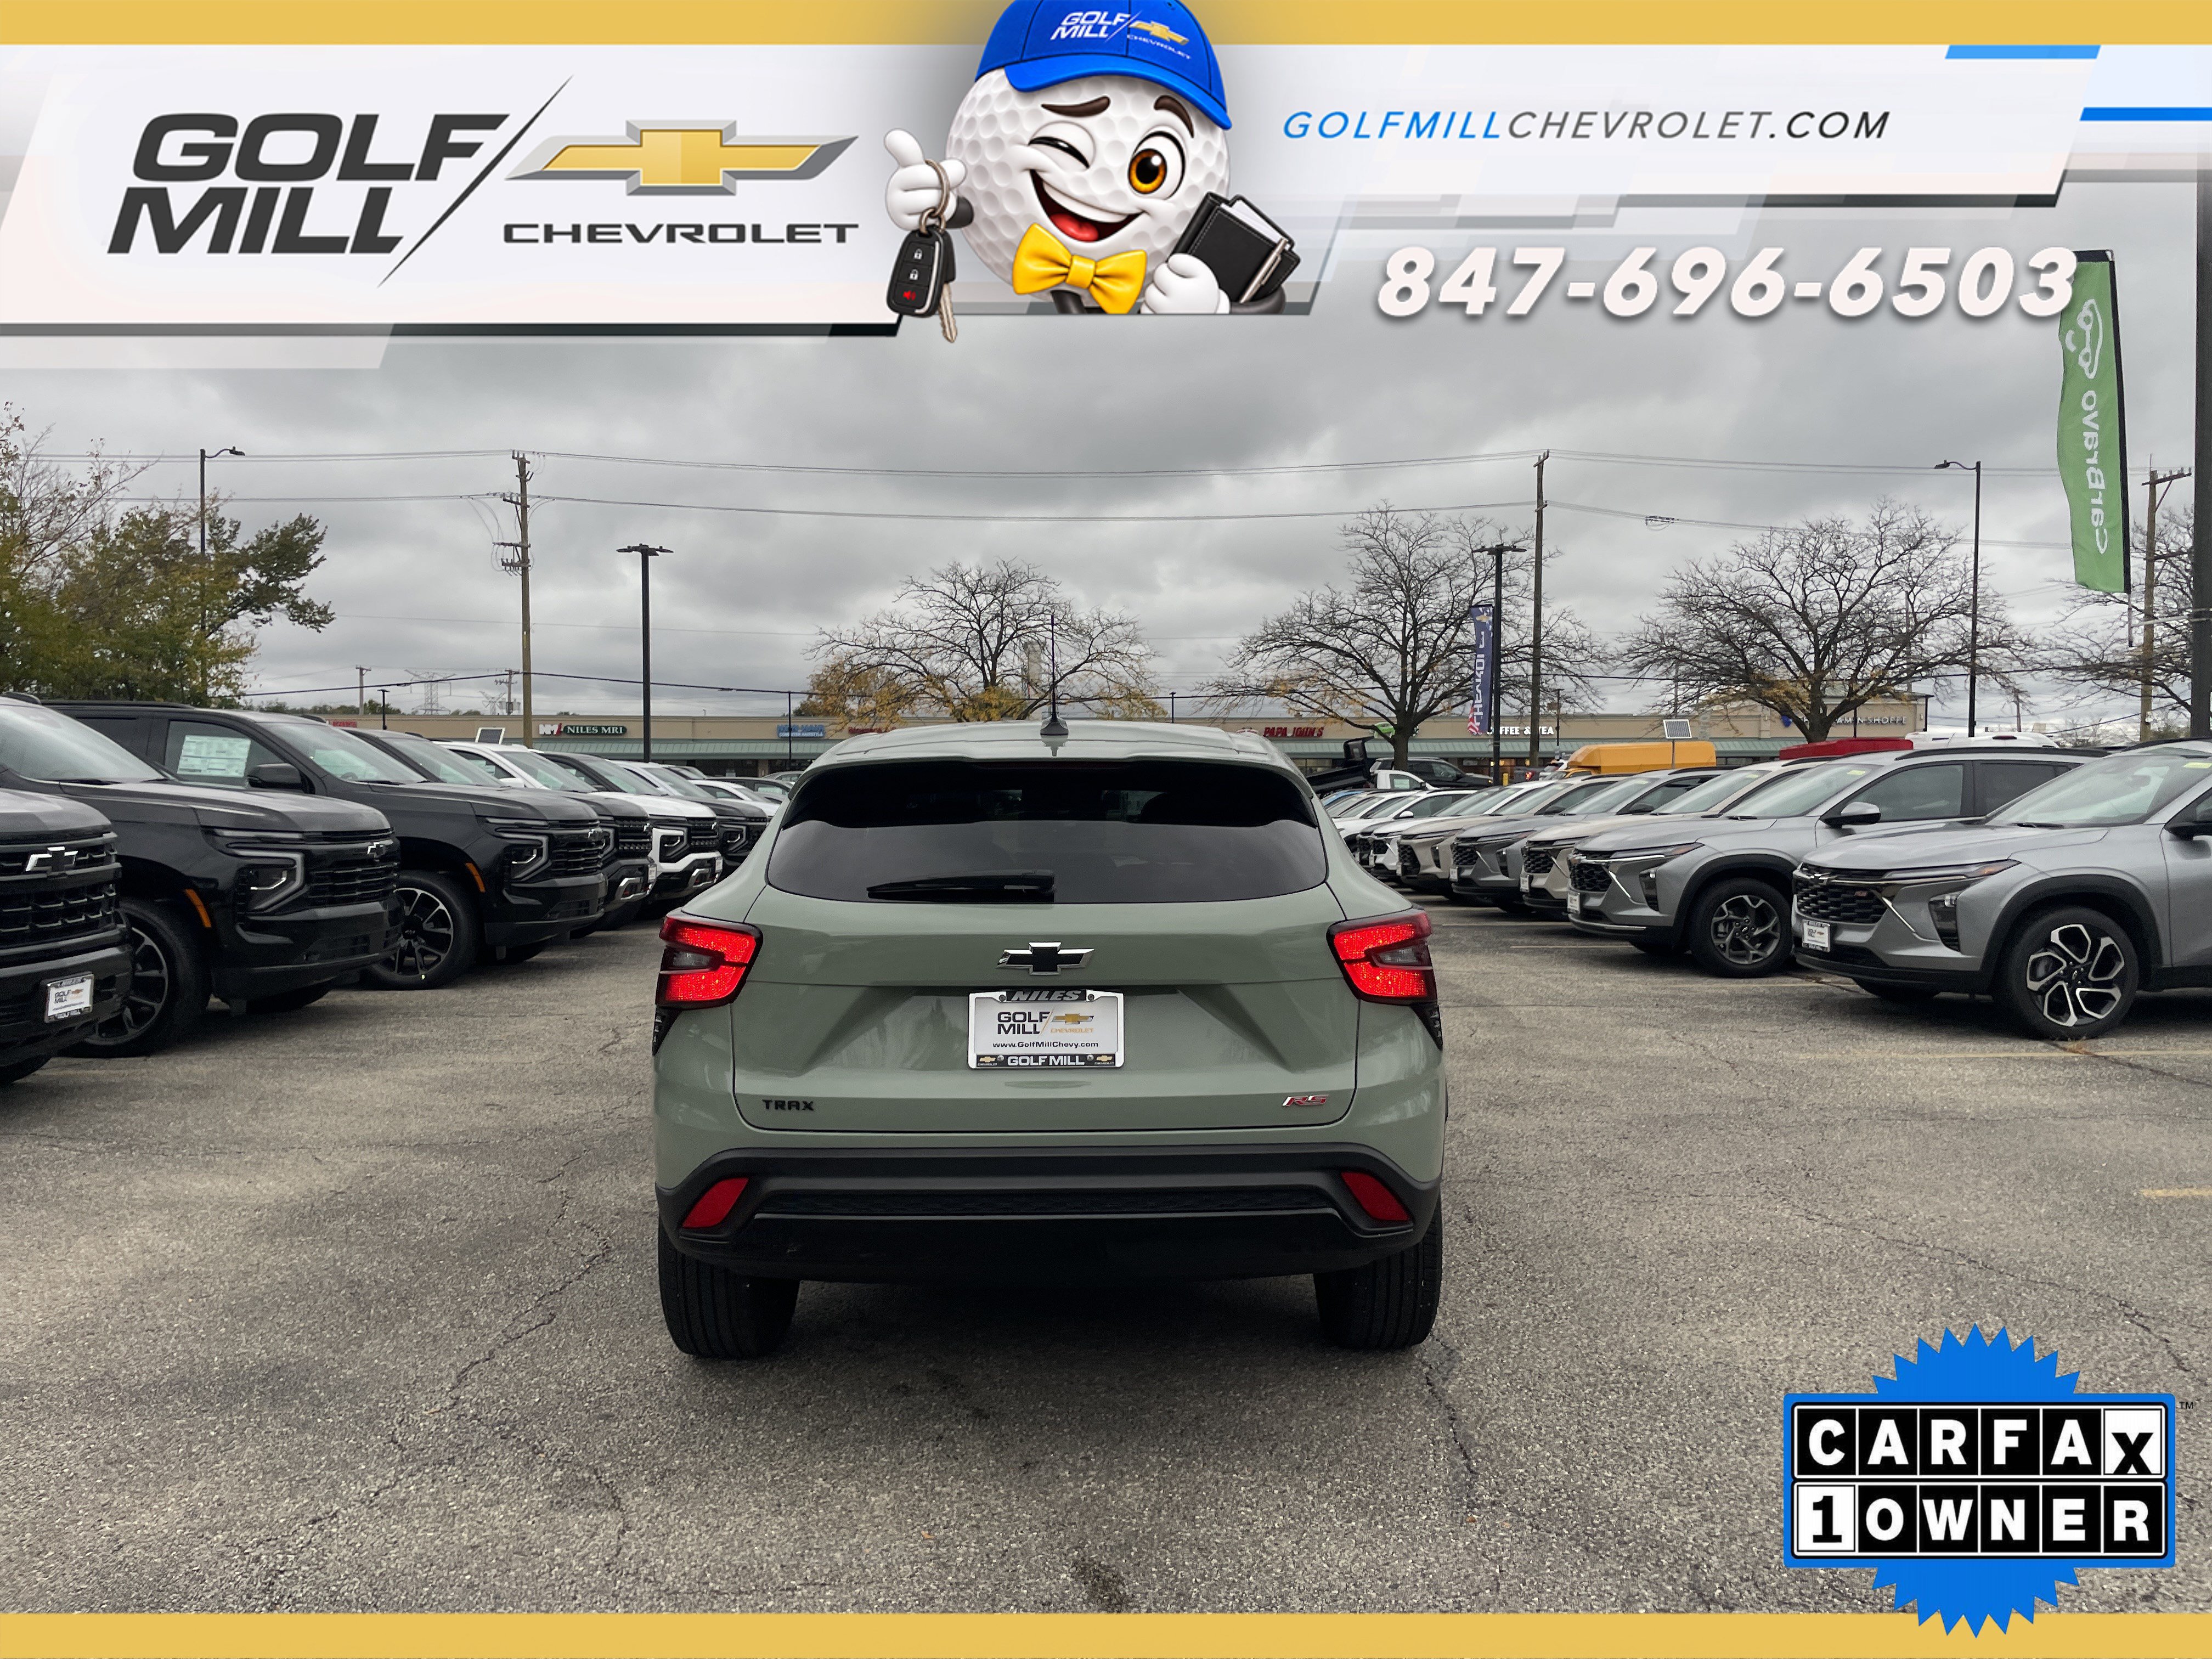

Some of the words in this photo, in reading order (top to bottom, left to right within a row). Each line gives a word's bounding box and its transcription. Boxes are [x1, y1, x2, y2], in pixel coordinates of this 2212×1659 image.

[1865, 716, 1908, 724] SHOPPE
[1263, 727, 1288, 737] PAPA
[1011, 990, 1081, 1001] NILES
[997, 1012, 1051, 1023] GOLF
[997, 1023, 1040, 1035] MILL
[1007, 1056, 1048, 1066] GOLF
[1049, 1056, 1085, 1065] MILL
[762, 1099, 814, 1111] TRAX
[1282, 1094, 1329, 1107] RS
